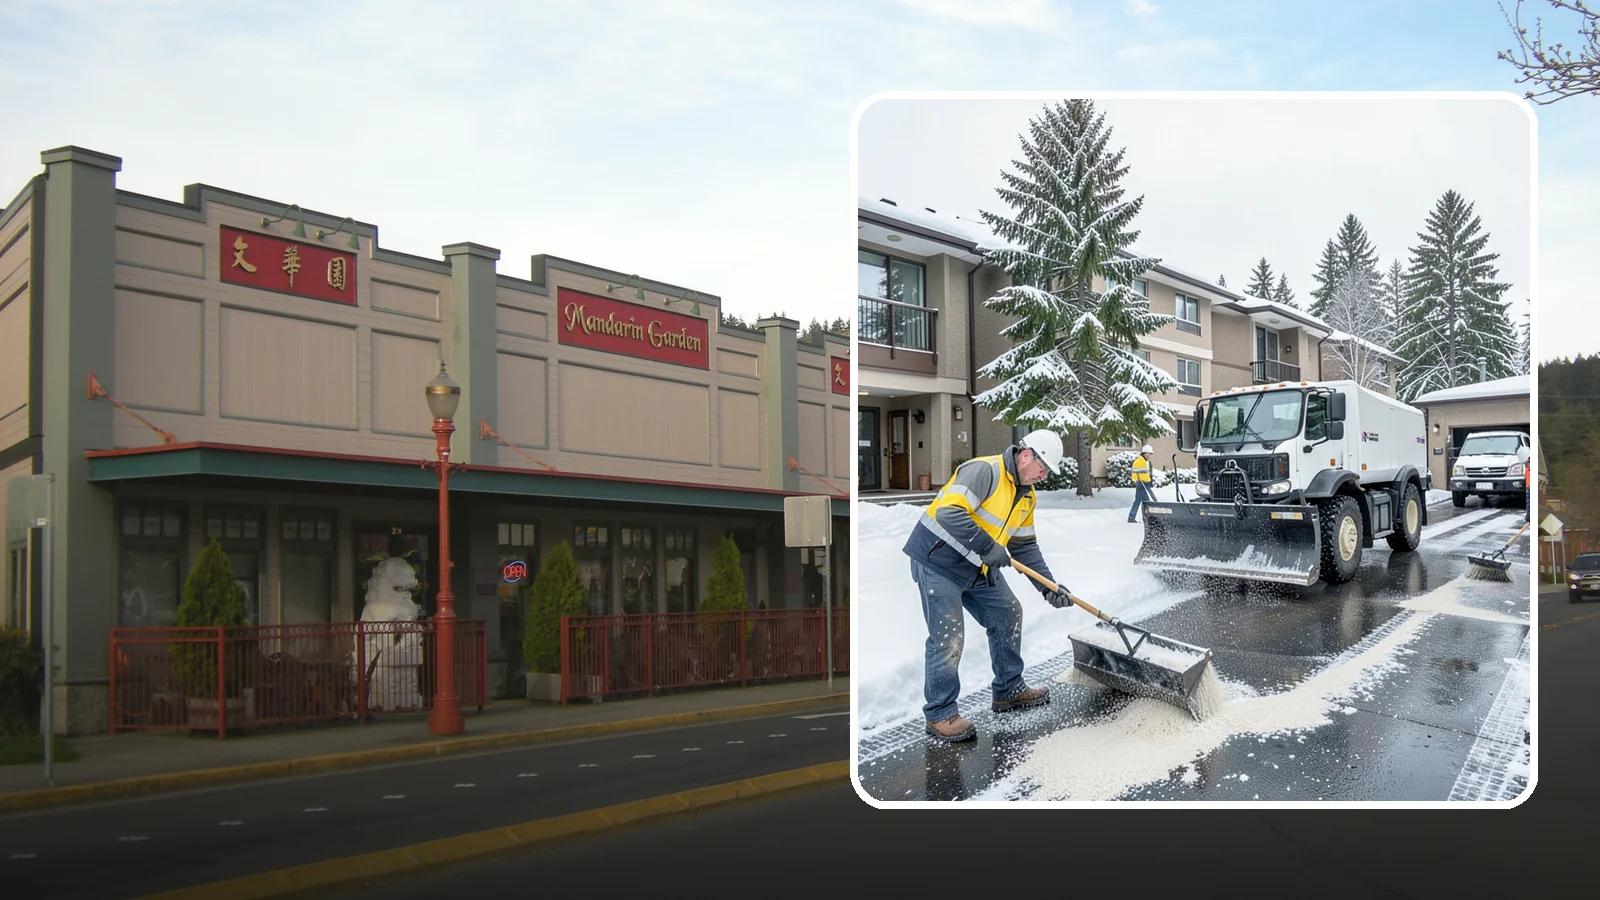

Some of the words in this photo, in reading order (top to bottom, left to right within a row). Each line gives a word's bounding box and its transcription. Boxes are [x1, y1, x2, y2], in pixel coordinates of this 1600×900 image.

[564, 302, 644, 341] Mandarin
[647, 320, 702, 352] Garden
[503, 565, 527, 578] OPEN
